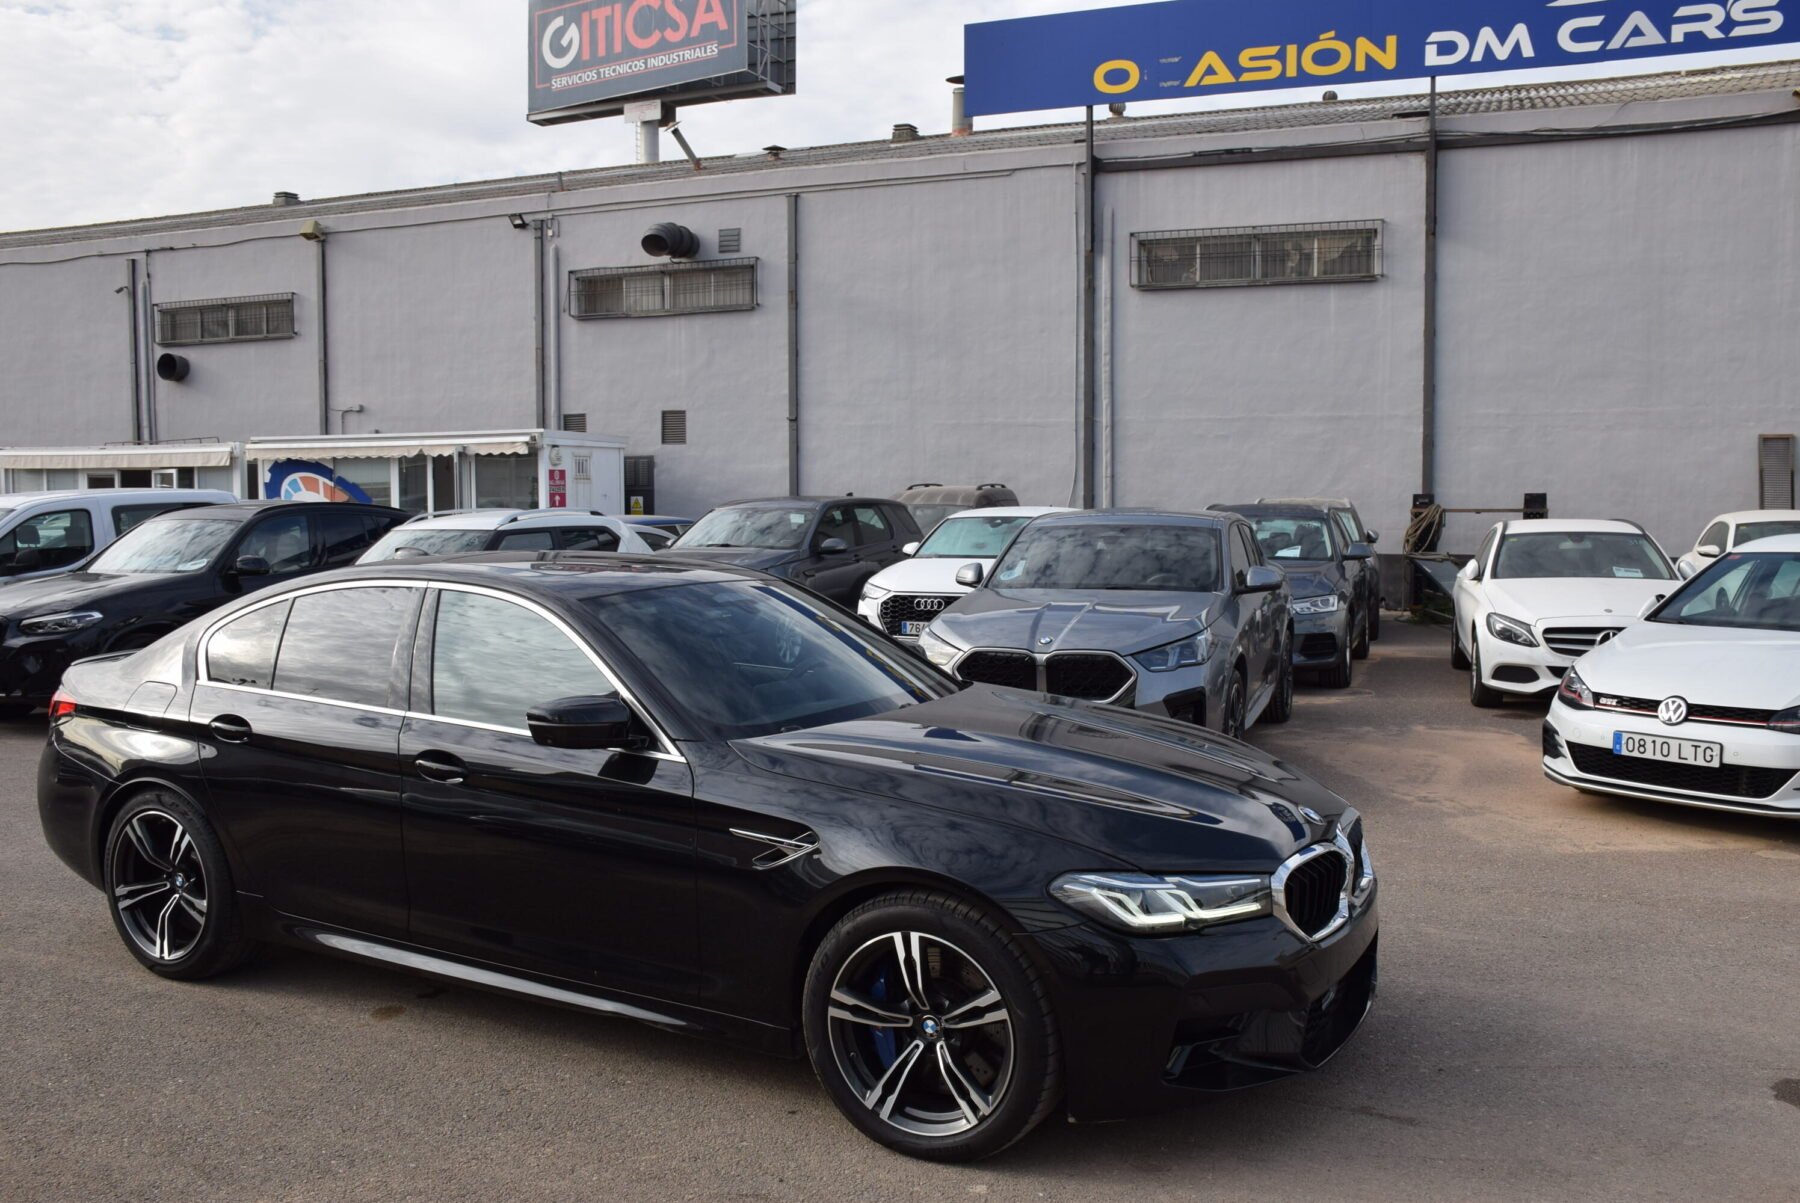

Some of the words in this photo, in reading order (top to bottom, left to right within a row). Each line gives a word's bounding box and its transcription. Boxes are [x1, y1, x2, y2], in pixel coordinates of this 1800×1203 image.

[542, 0, 728, 69] GITICSA
[1424, 22, 1535, 67] DM
[1557, 0, 1784, 53] CARS
[551, 71, 598, 89] SERVICIOS
[599, 59, 646, 79] TECNICOS
[647, 43, 718, 68] INDUSTRIALES
[1625, 736, 1671, 758] 0810
[1678, 743, 1715, 763] LTG
